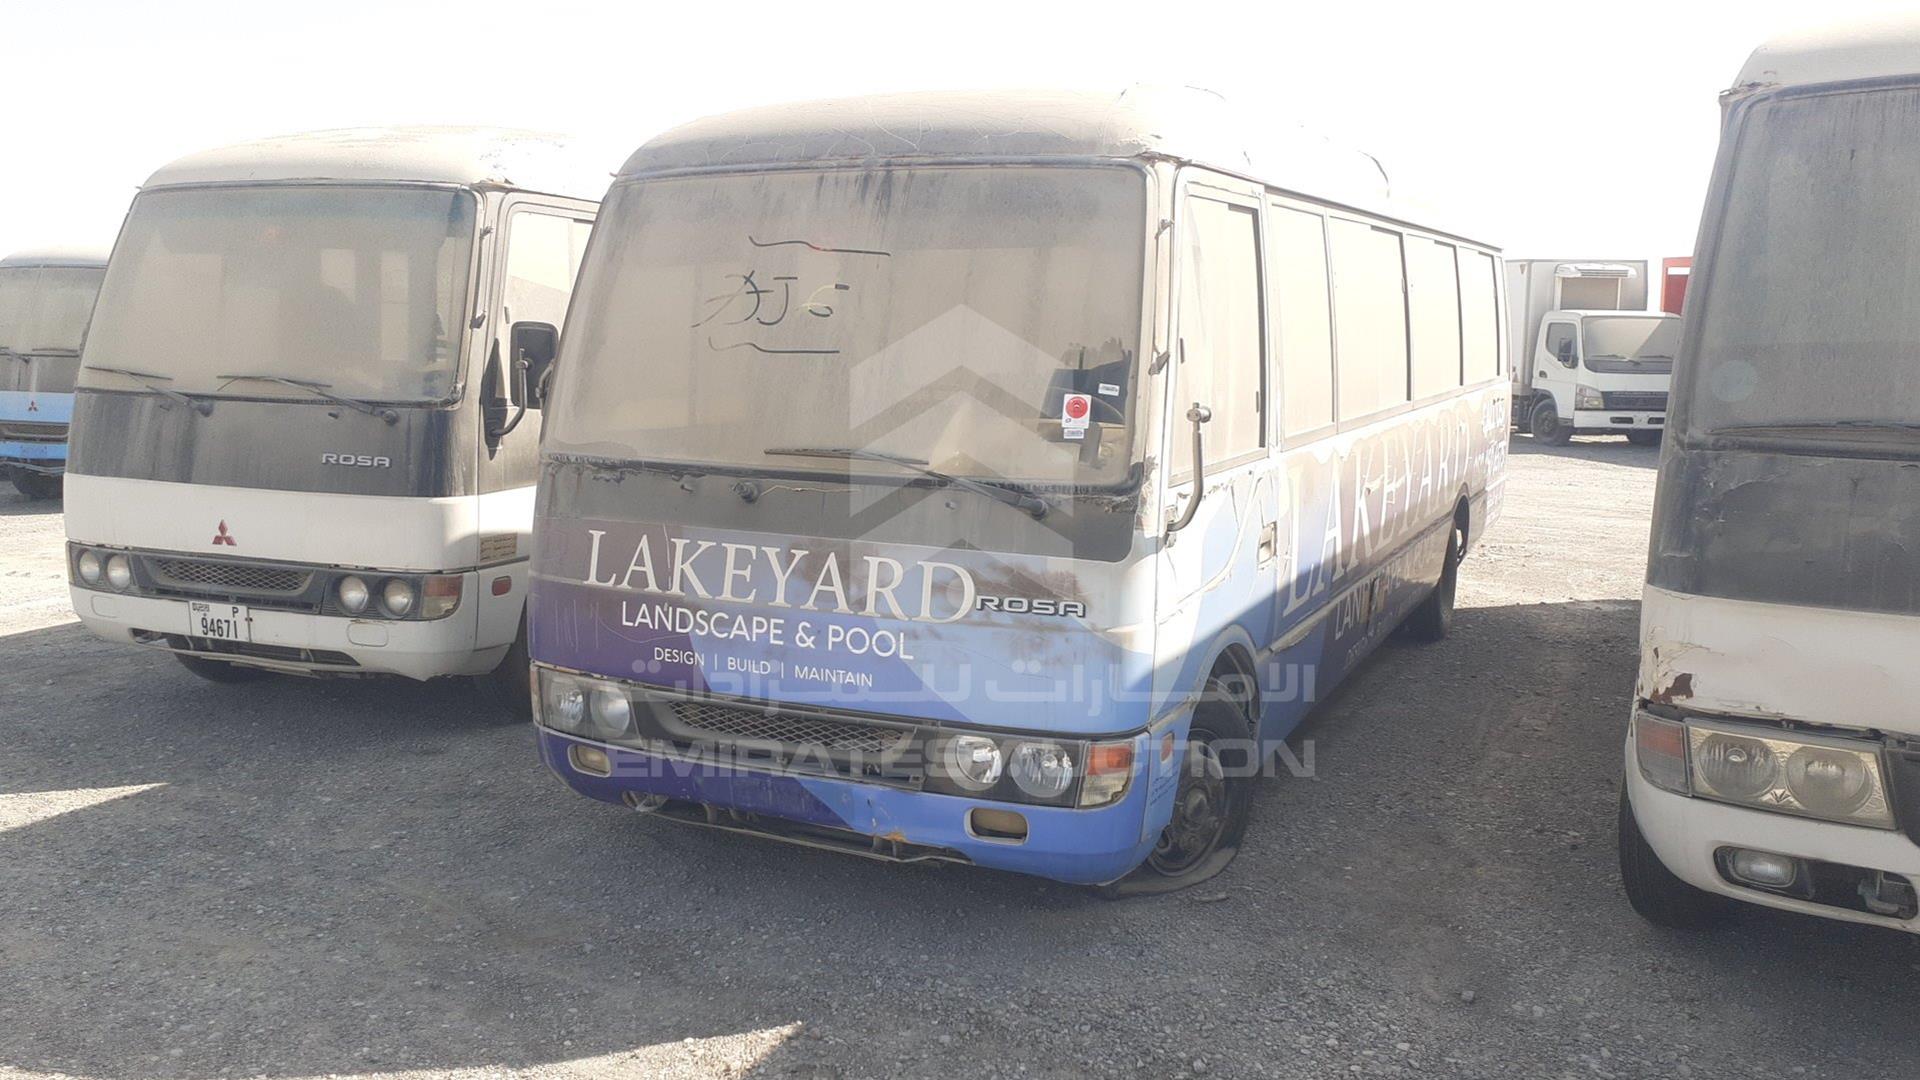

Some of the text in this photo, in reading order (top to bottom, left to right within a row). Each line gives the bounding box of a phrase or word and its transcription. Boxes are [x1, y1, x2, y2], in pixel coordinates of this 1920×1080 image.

[321, 453, 391, 468] ROSA
[1282, 408, 1471, 617] LAKEYARD
[583, 529, 976, 625] LAKEYARD
[232, 606, 239, 618] P
[976, 595, 1086, 618] ROSA
[201, 617, 238, 639] 94671
[621, 601, 915, 661] LANDSCAPE & POOL
[654, 647, 705, 667] DESIGN
[727, 656, 771, 675] BUILD
[794, 664, 873, 687] MAINTAIN
